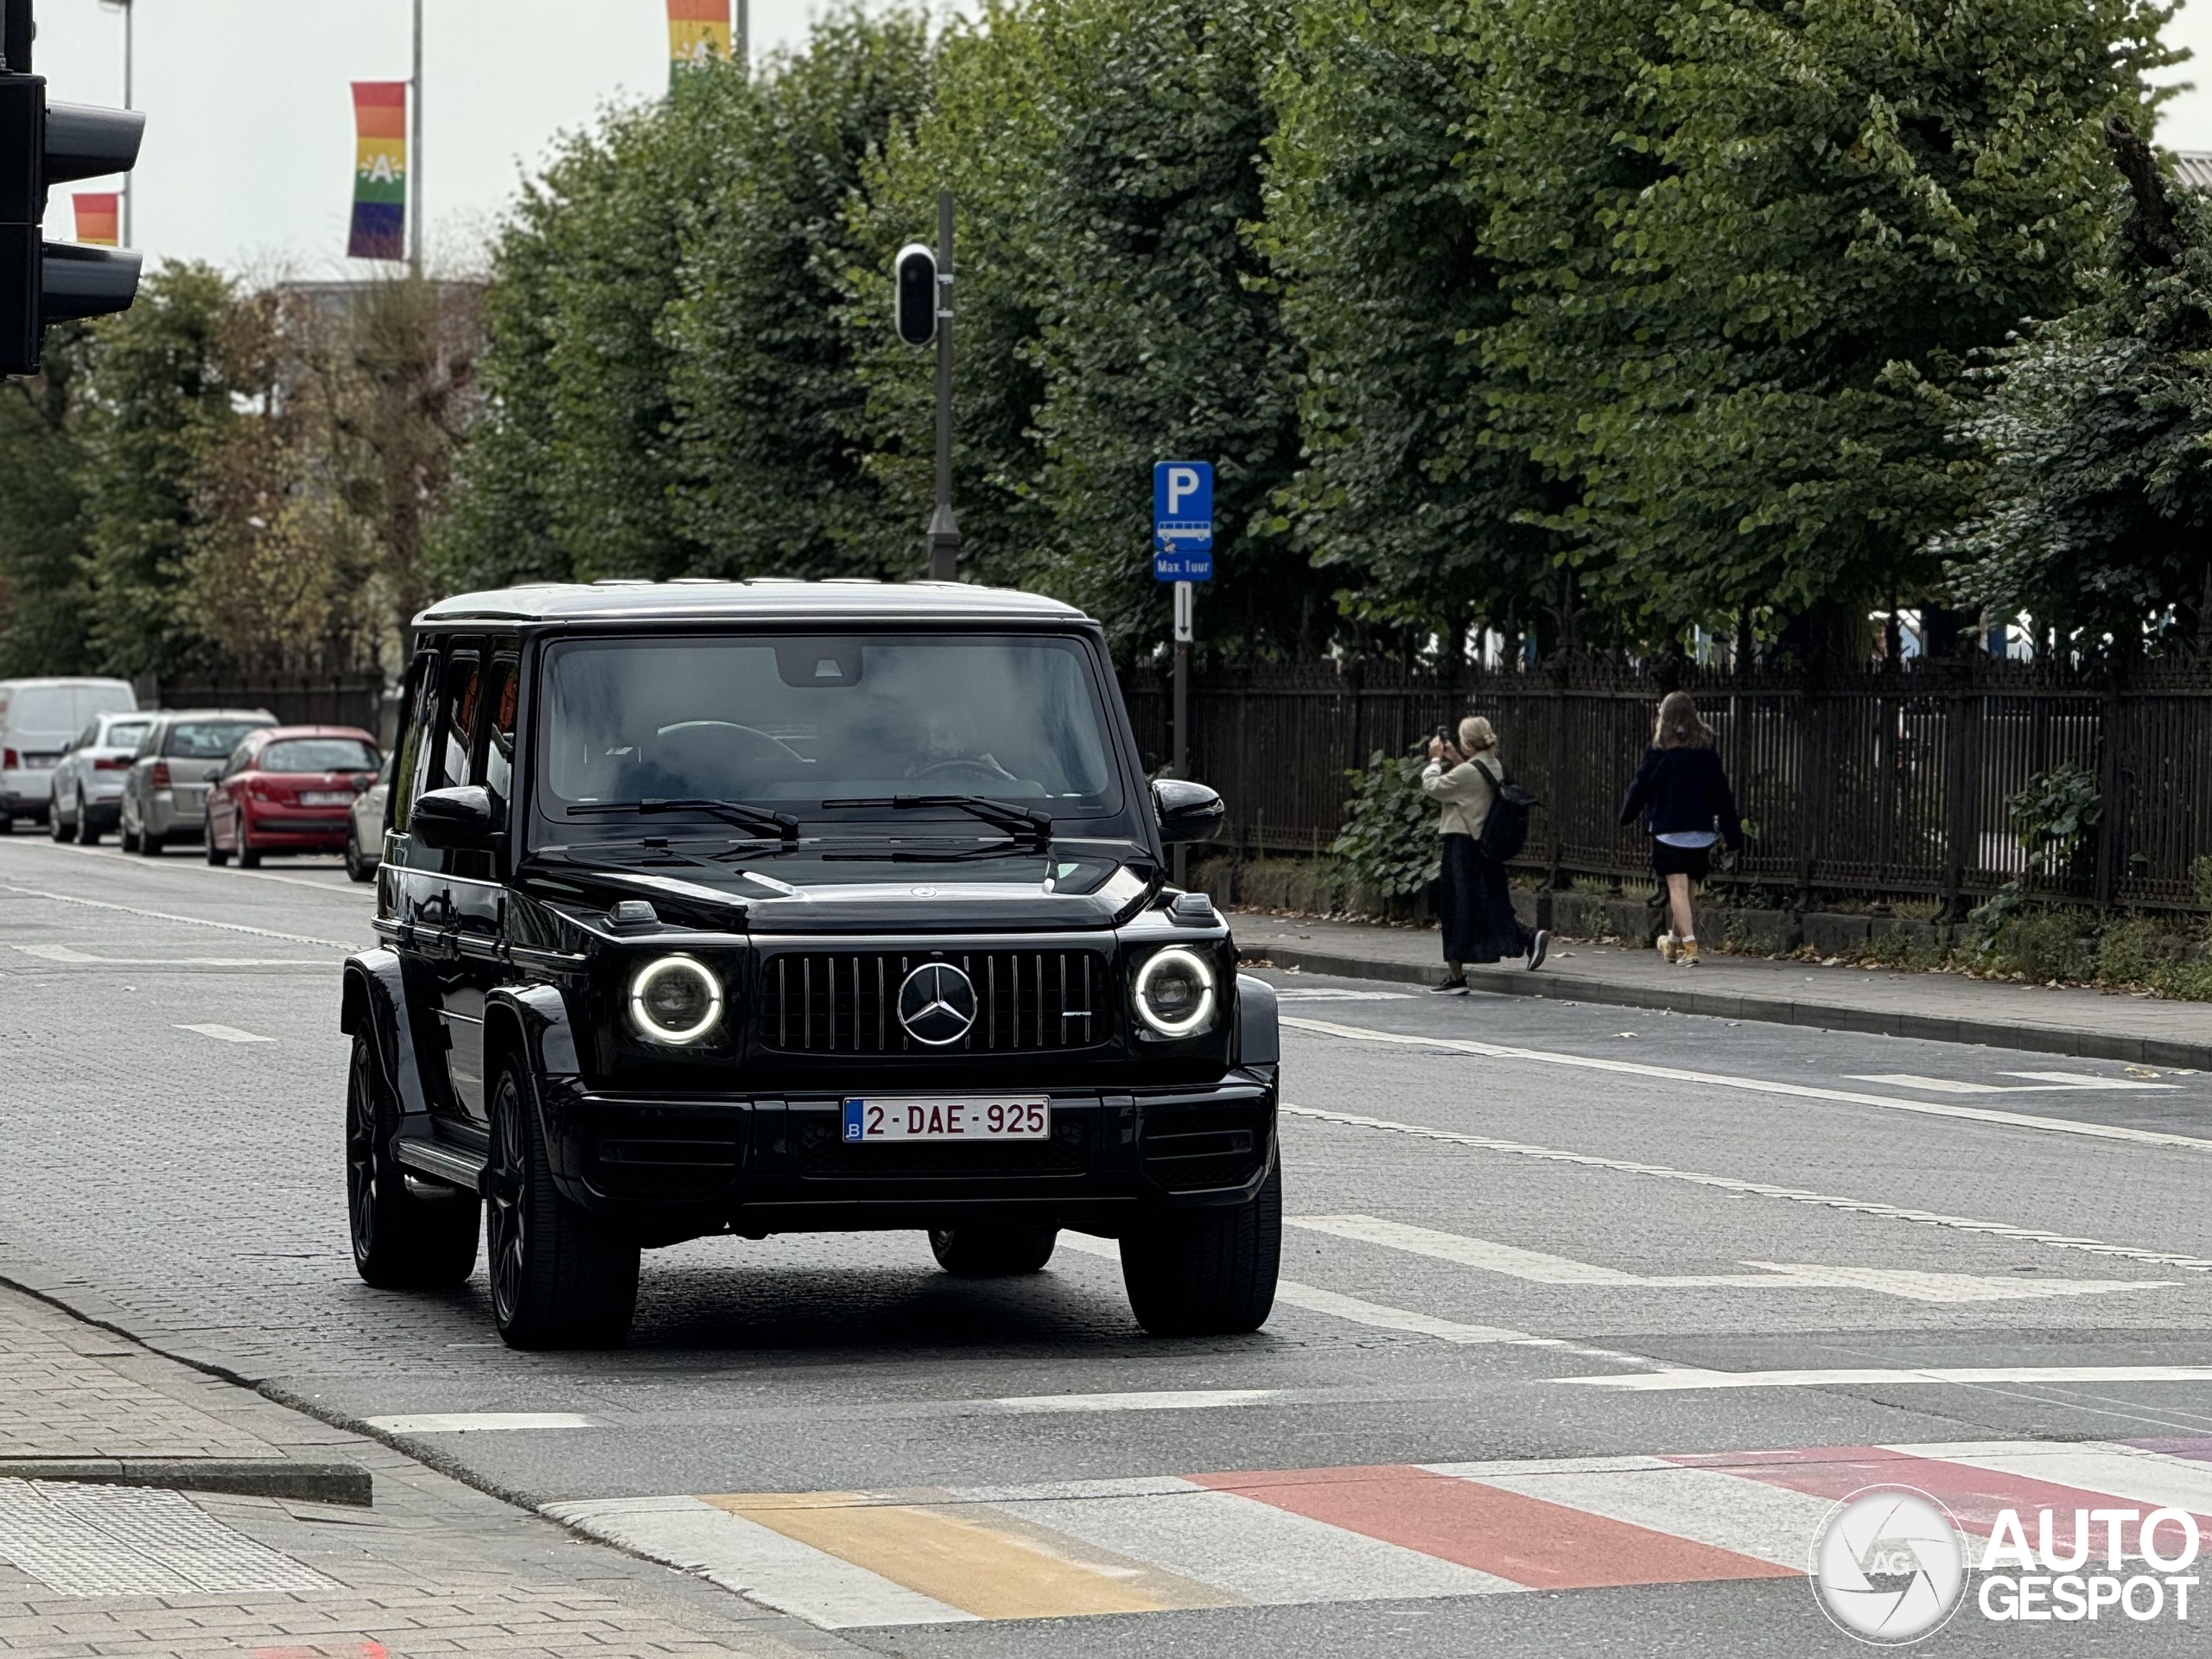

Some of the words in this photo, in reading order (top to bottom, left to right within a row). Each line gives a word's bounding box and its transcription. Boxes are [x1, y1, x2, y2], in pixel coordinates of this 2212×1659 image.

[368, 153, 394, 185] A
[1168, 467, 1199, 514] P
[849, 1124, 860, 1137] B
[867, 1104, 1045, 1135] 2-DAE-925
